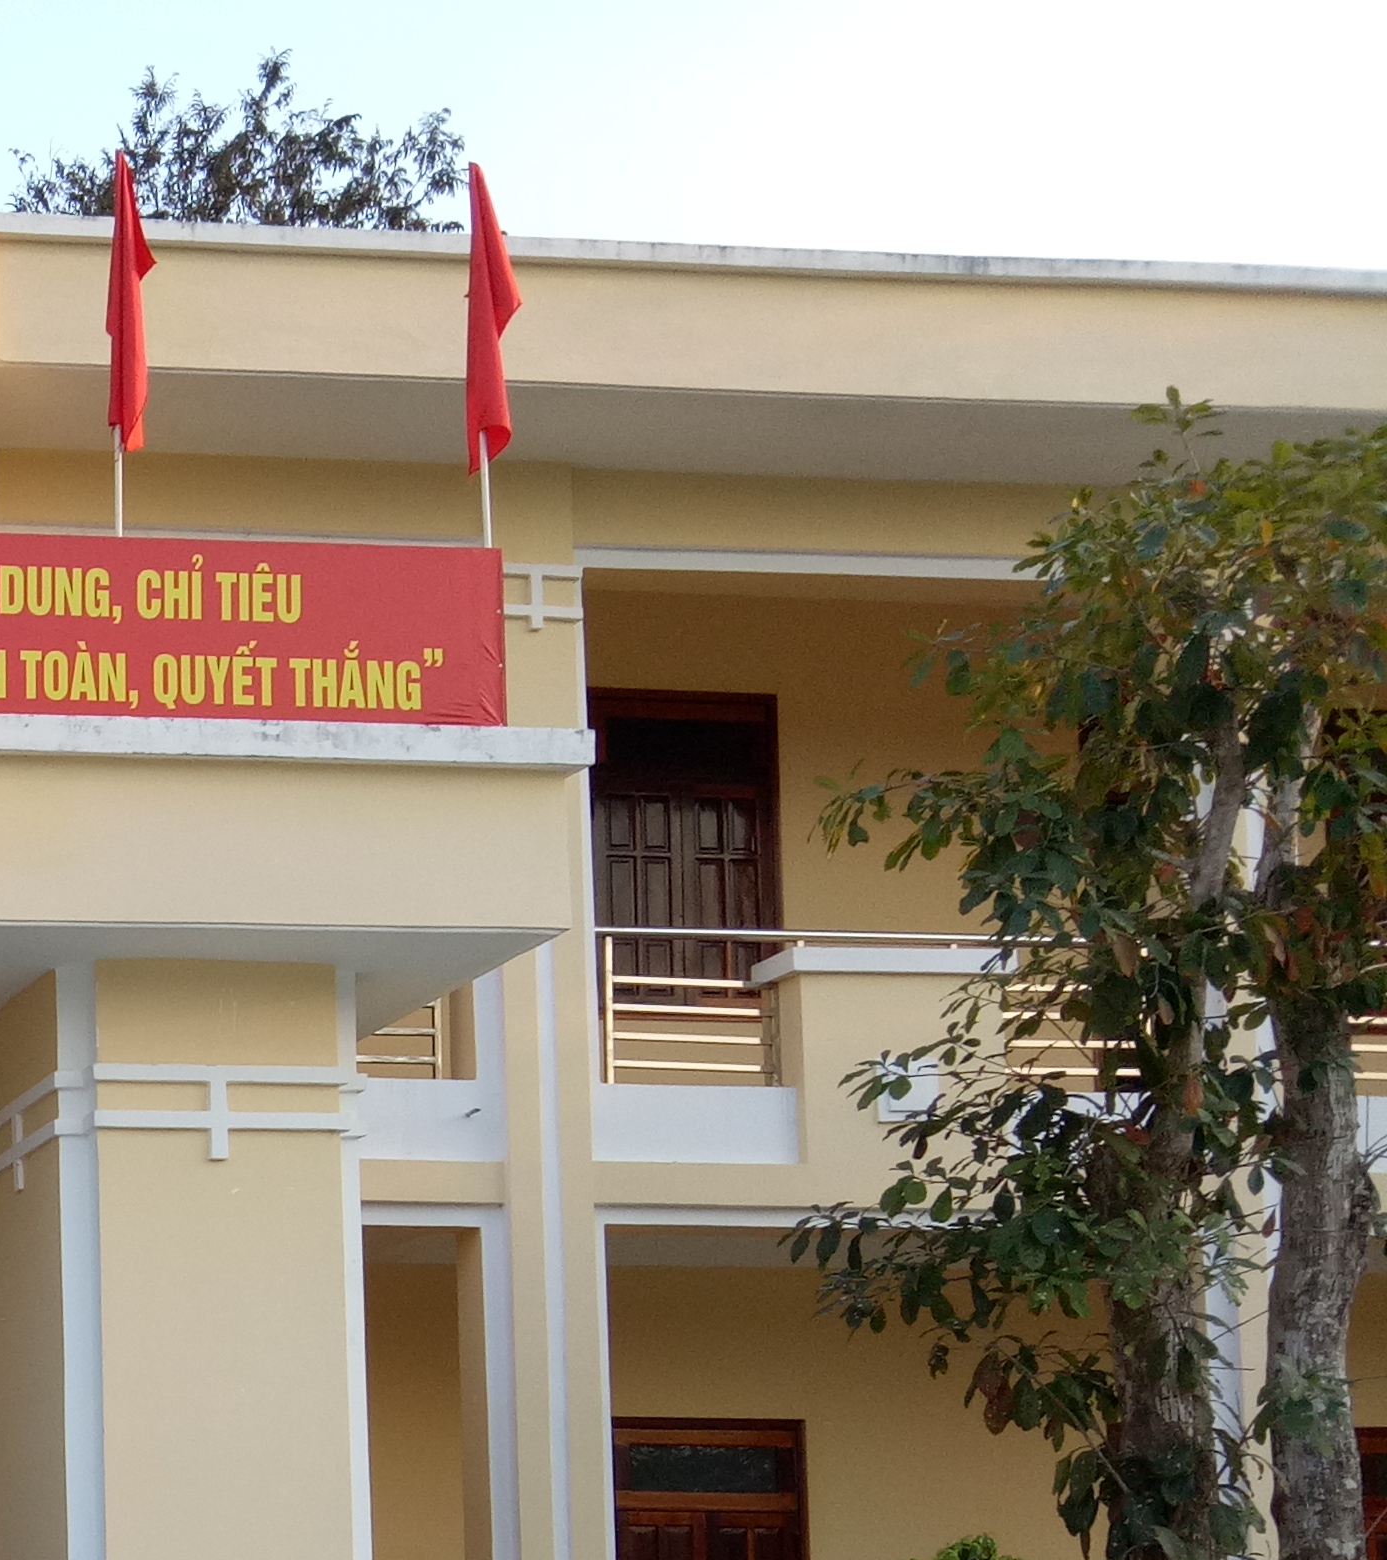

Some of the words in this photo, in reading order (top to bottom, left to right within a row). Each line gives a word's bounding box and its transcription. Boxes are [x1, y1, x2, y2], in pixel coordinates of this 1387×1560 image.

[136, 554, 204, 620] CHỈ
[215, 563, 302, 624] TIÊU
[153, 641, 278, 710] QUYẾT
